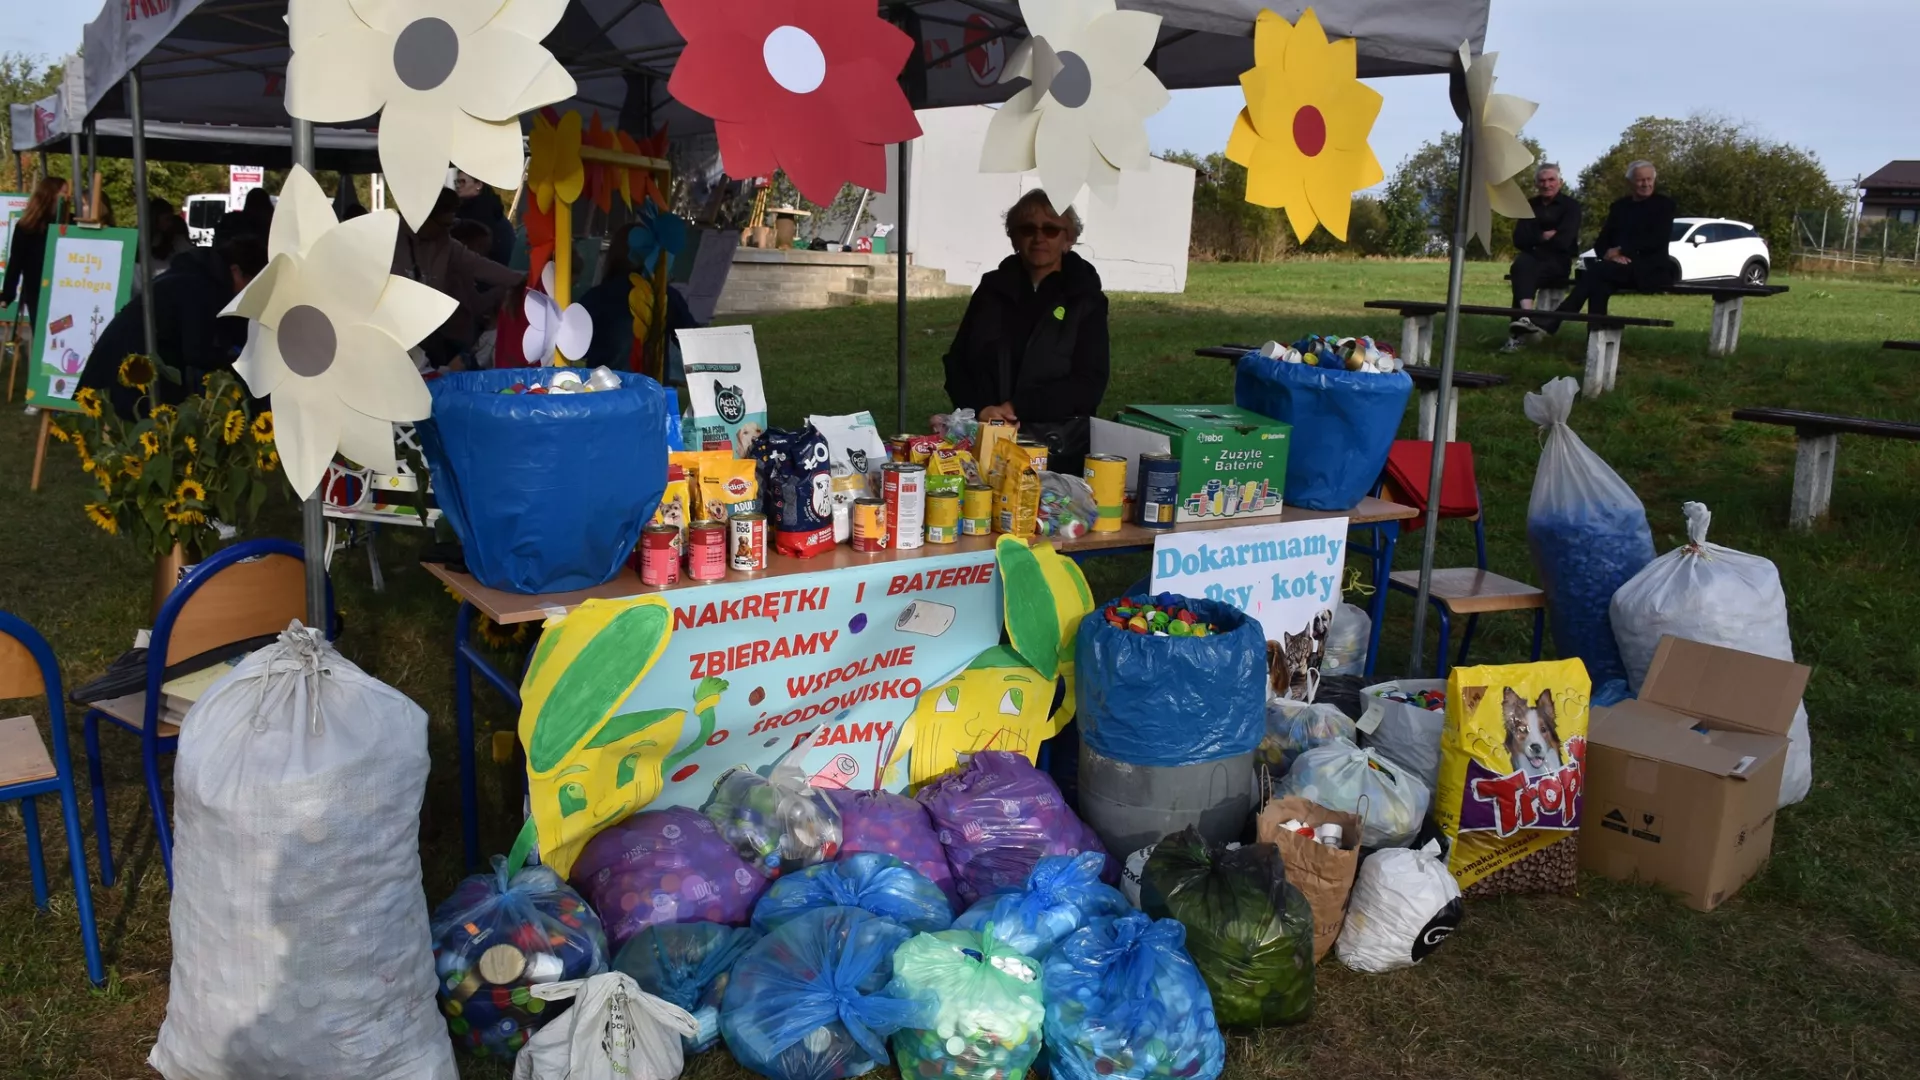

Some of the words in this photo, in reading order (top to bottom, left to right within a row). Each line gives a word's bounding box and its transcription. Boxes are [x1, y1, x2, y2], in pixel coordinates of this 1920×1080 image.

[724, 406, 738, 416] Pet
[1215, 460, 1264, 471] Baterie
[1220, 449, 1262, 461] Zużyte
[1156, 534, 1343, 580] Dokarmiamy
[672, 587, 830, 632] NAKRĘTKI
[855, 582, 866, 604] I
[887, 563, 995, 596] BATERIE
[1271, 571, 1335, 602] koty
[690, 630, 839, 680] ZBIERAMY
[787, 646, 916, 698] WSPOLNIE
[706, 729, 729, 746] O
[748, 677, 922, 736] ŚRODOWISKO
[1456, 869, 1463, 877] o
[1463, 853, 1494, 873] smaku
[1494, 832, 1541, 857] kurczaka
[1474, 858, 1503, 875] chicken
